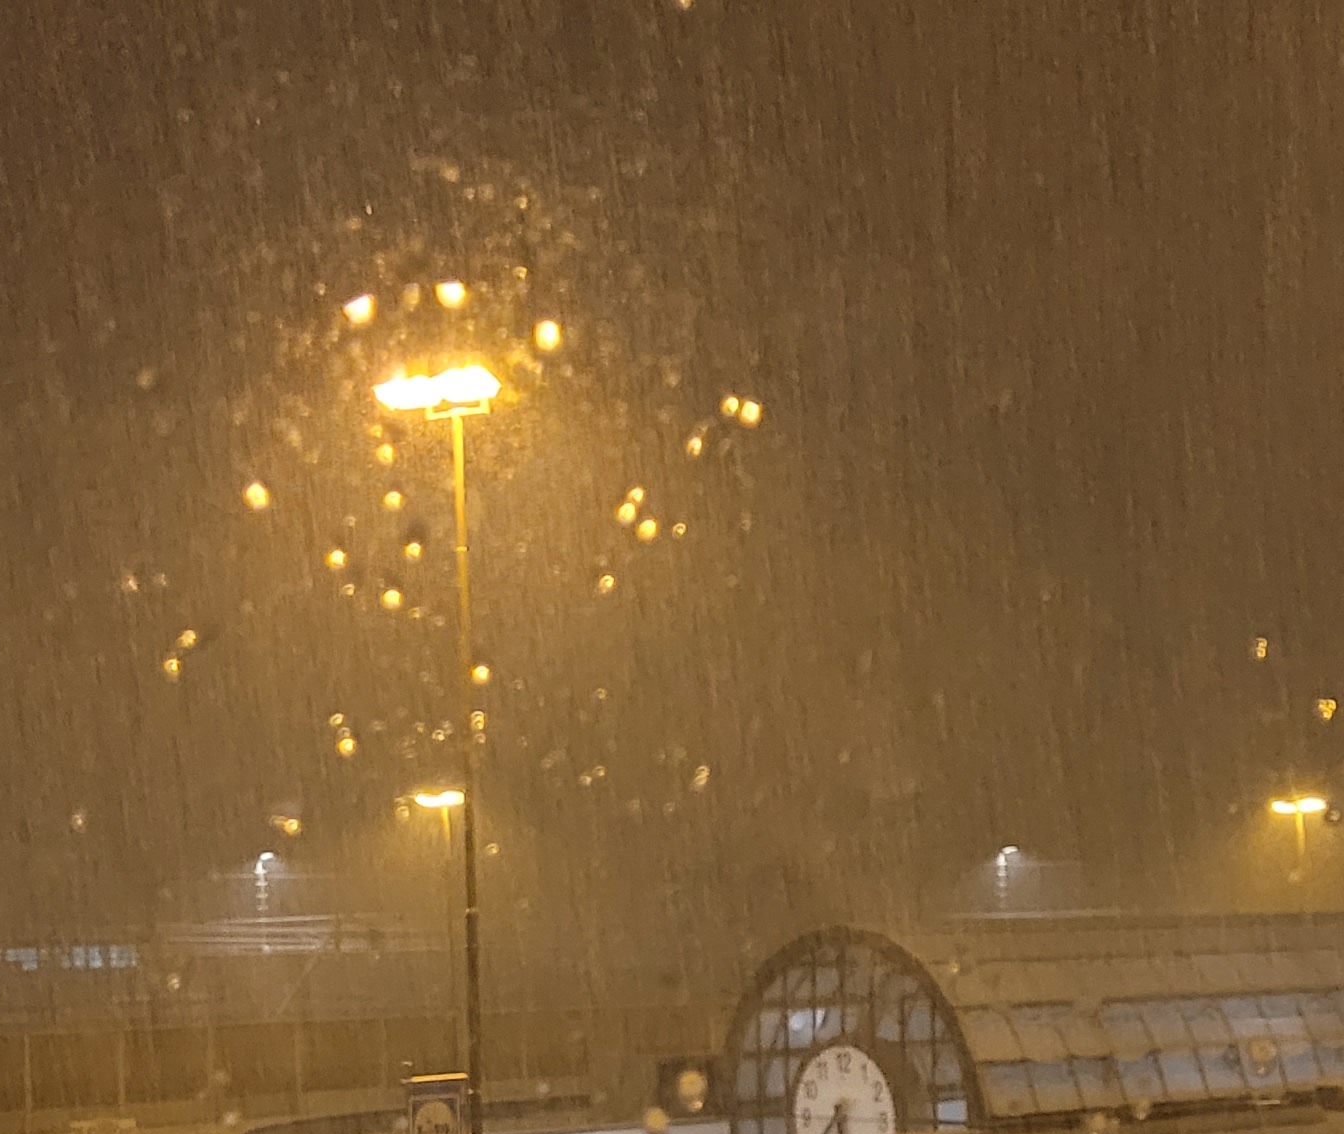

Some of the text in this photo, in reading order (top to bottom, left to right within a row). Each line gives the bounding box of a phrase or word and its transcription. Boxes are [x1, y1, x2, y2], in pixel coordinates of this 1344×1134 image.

[836, 1051, 852, 1074] 12
[804, 1079, 818, 1101] 10
[873, 1081, 883, 1103] 2
